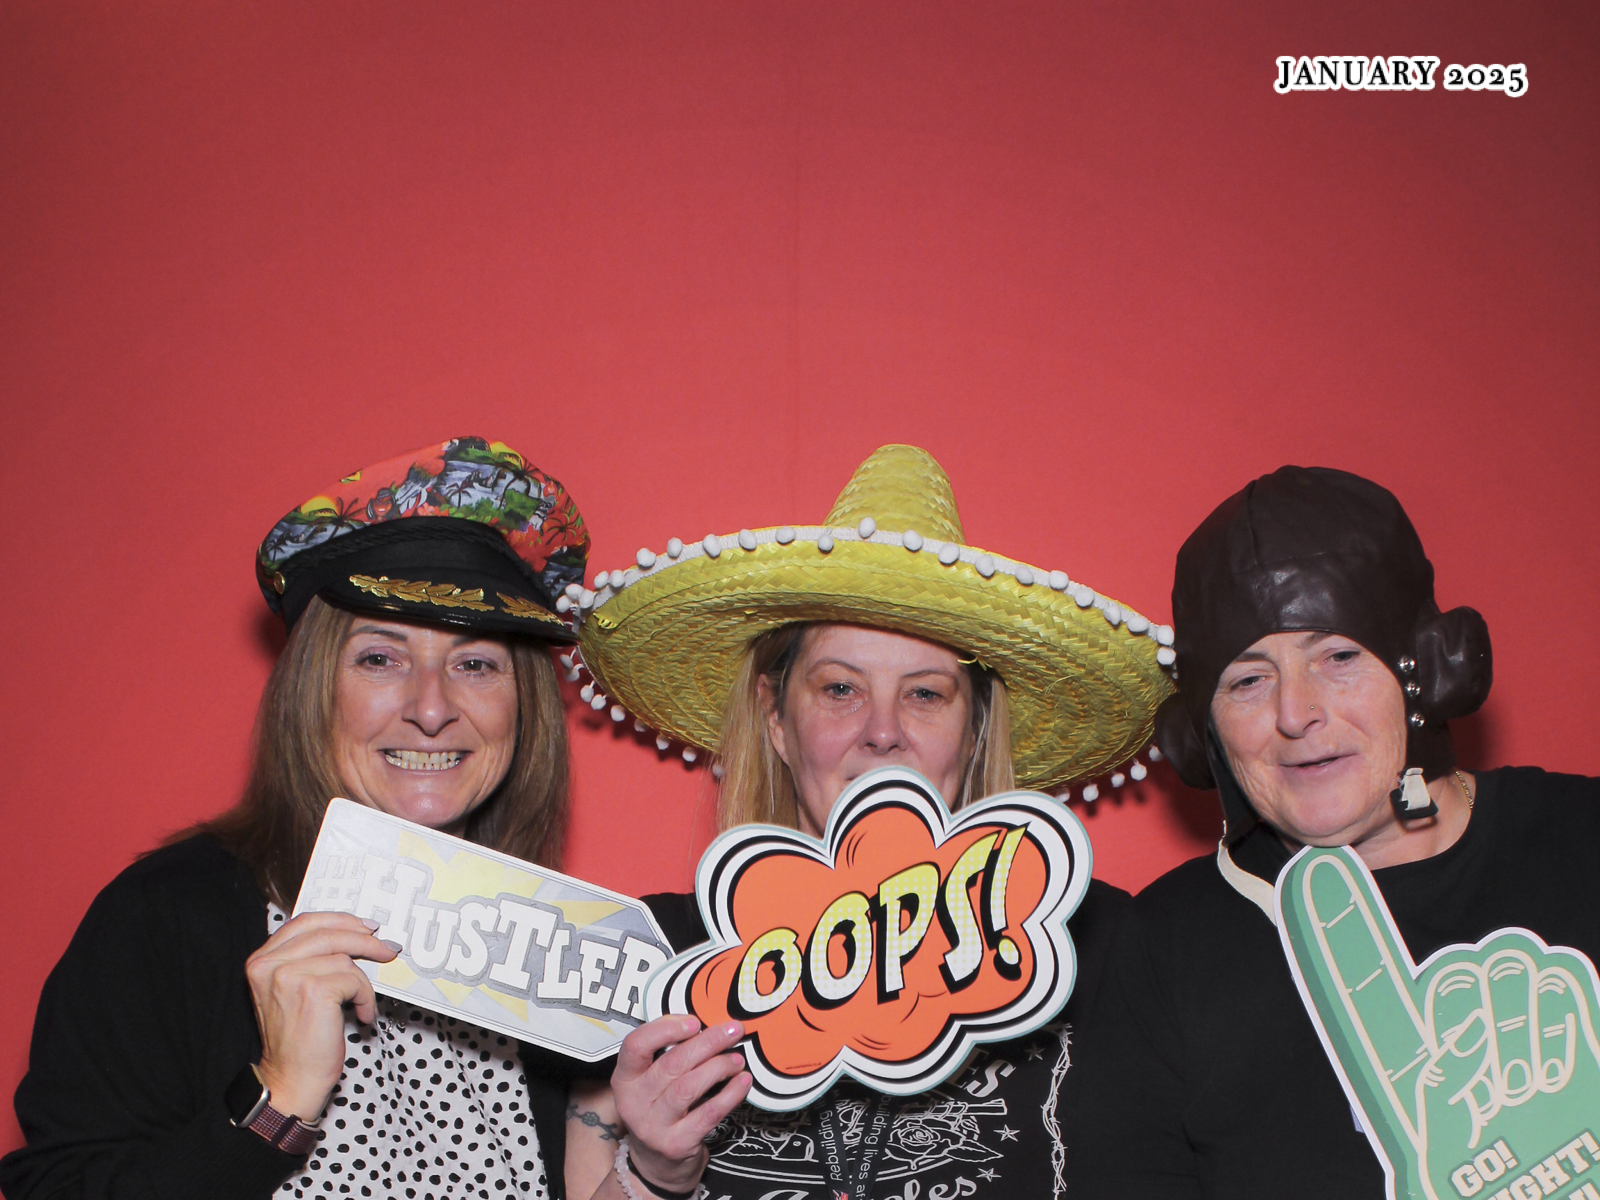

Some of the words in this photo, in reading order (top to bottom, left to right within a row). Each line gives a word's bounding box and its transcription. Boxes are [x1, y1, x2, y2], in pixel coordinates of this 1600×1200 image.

[726, 820, 1032, 1021] OOPS!
[818, 1109, 844, 1182] Rebuilding
[864, 1094, 896, 1146] building
[858, 1148, 879, 1180] lives
[1450, 1139, 1519, 1198] GO!
